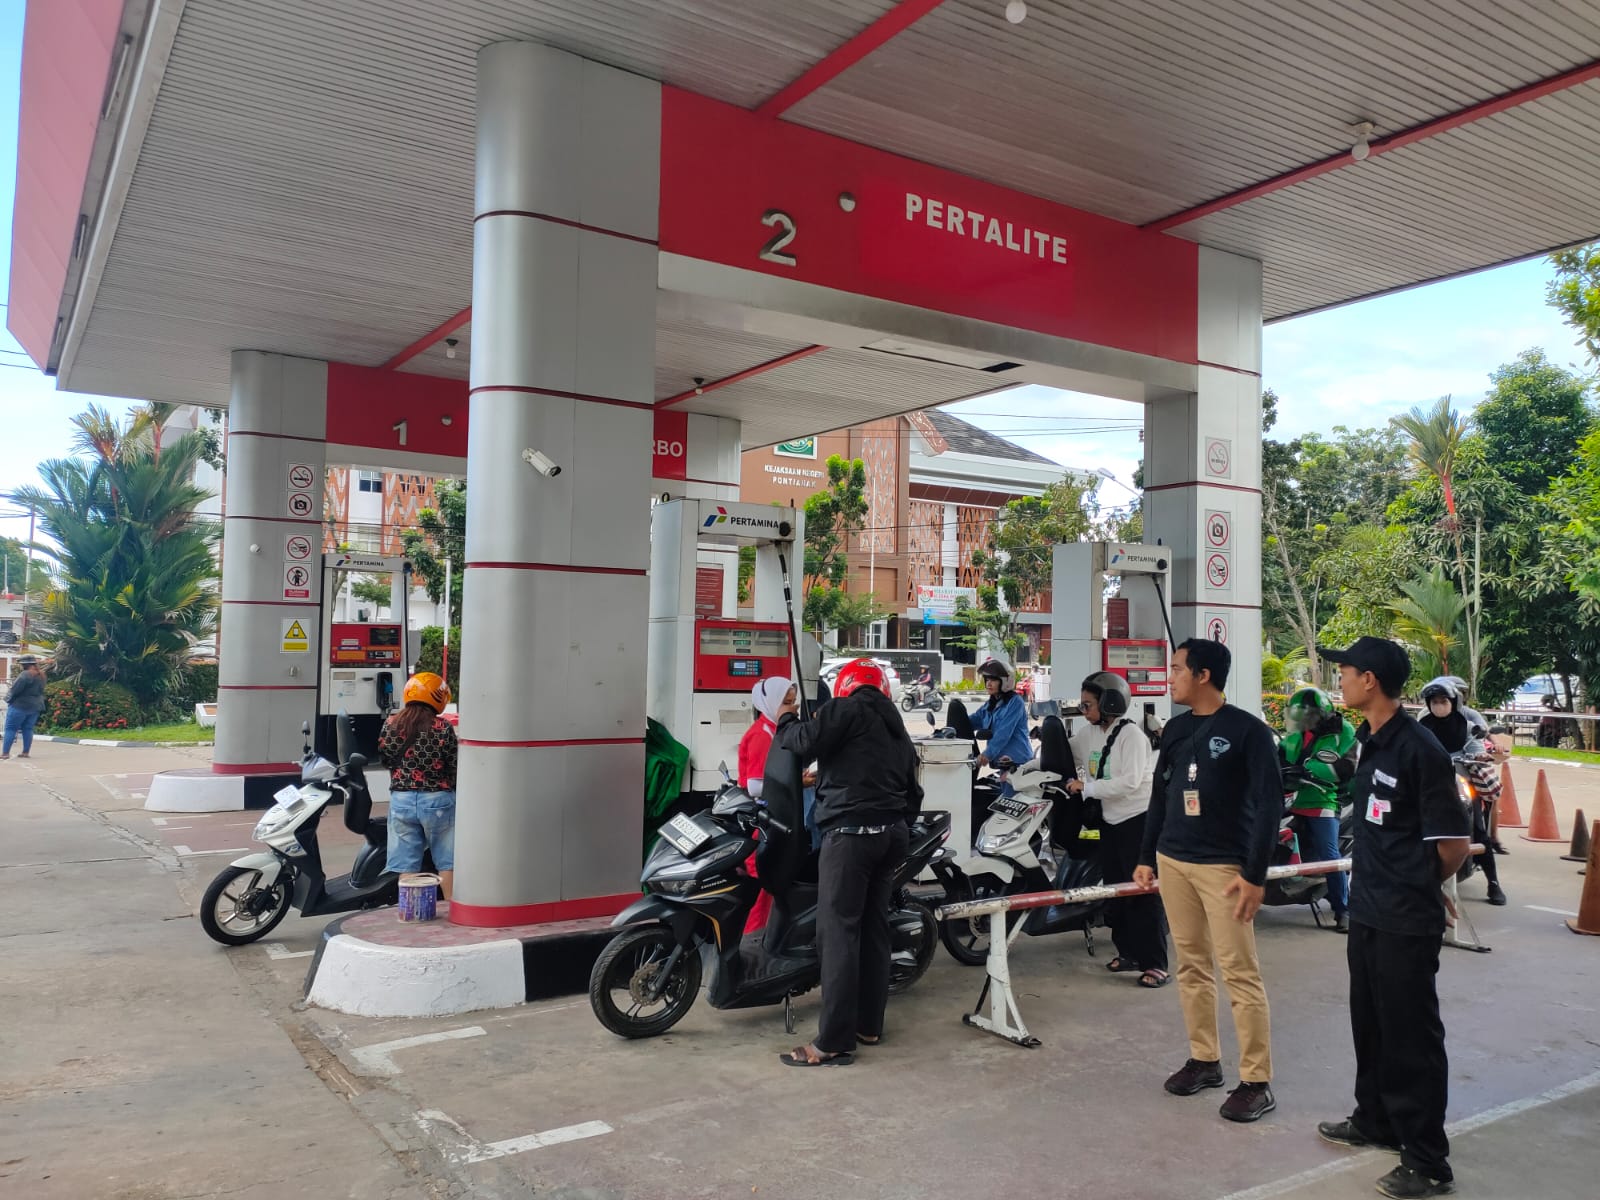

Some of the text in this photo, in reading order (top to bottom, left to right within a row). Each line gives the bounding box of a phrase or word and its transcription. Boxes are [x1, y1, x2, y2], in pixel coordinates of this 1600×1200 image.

[905, 192, 1068, 265] PERTALITE
[759, 208, 798, 268] 2
[392, 418, 408, 446] 1
[764, 463, 801, 476] KEJAKSAAN
[772, 476, 817, 488] PONTIANAK
[730, 516, 779, 529] PERTAMINA
[1127, 555, 1157, 563] PERTAMINA
